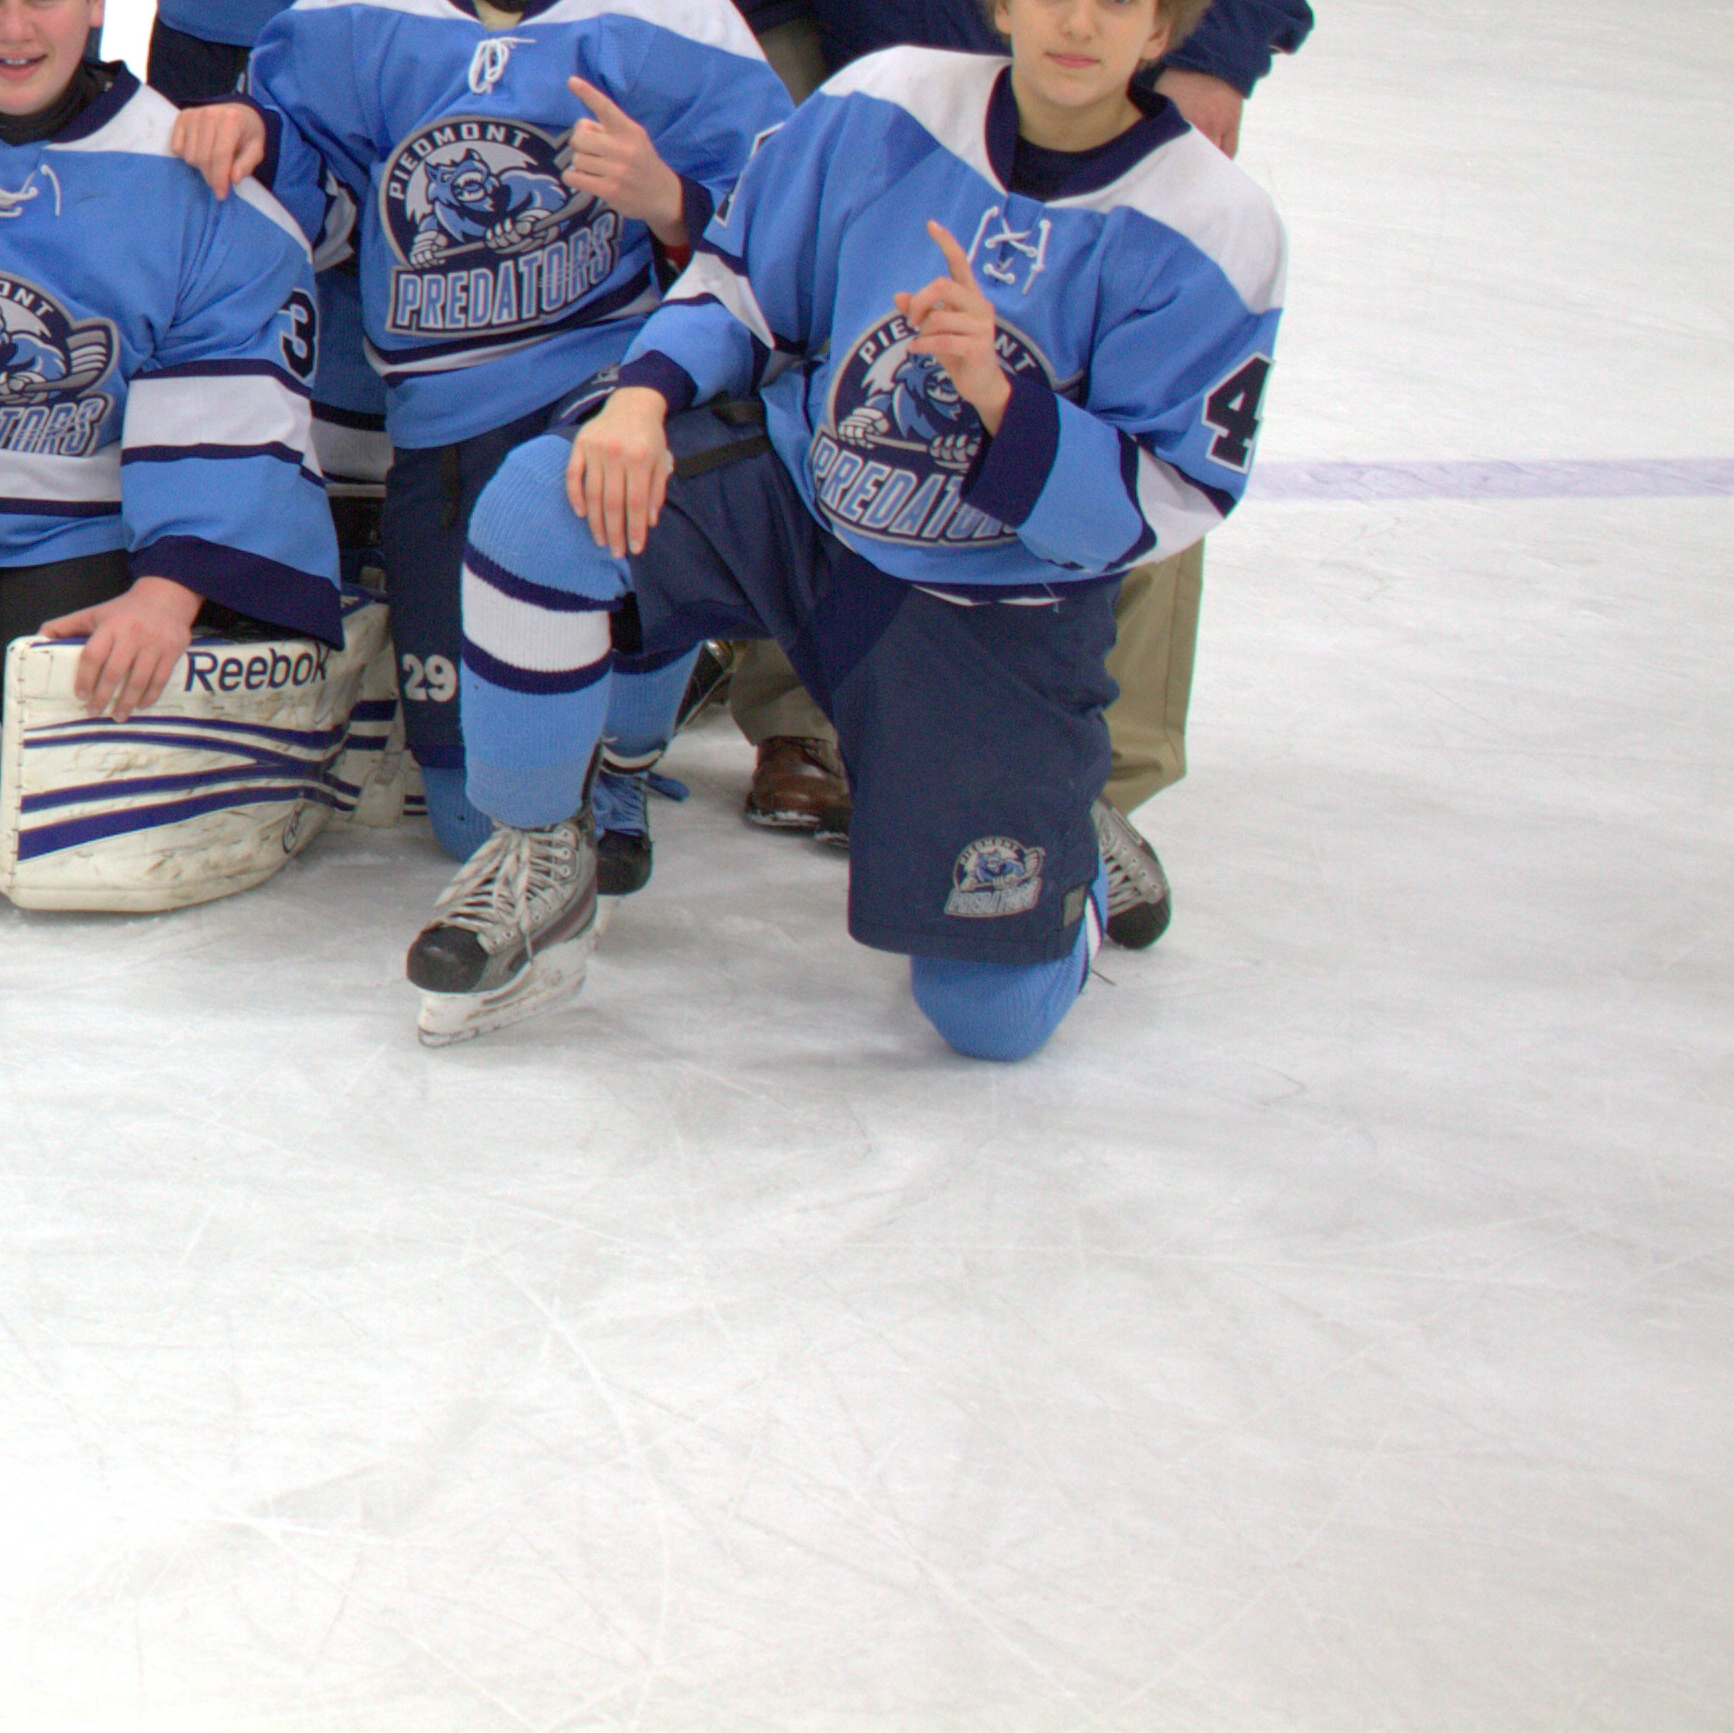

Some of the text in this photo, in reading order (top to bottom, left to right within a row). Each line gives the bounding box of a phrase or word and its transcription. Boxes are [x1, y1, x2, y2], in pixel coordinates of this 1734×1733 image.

[388, 122, 530, 201] PIEDMONT
[394, 212, 621, 332] PREDATORS
[1202, 351, 1275, 474] 4
[183, 641, 333, 693] Reebok
[401, 654, 458, 702] 29
